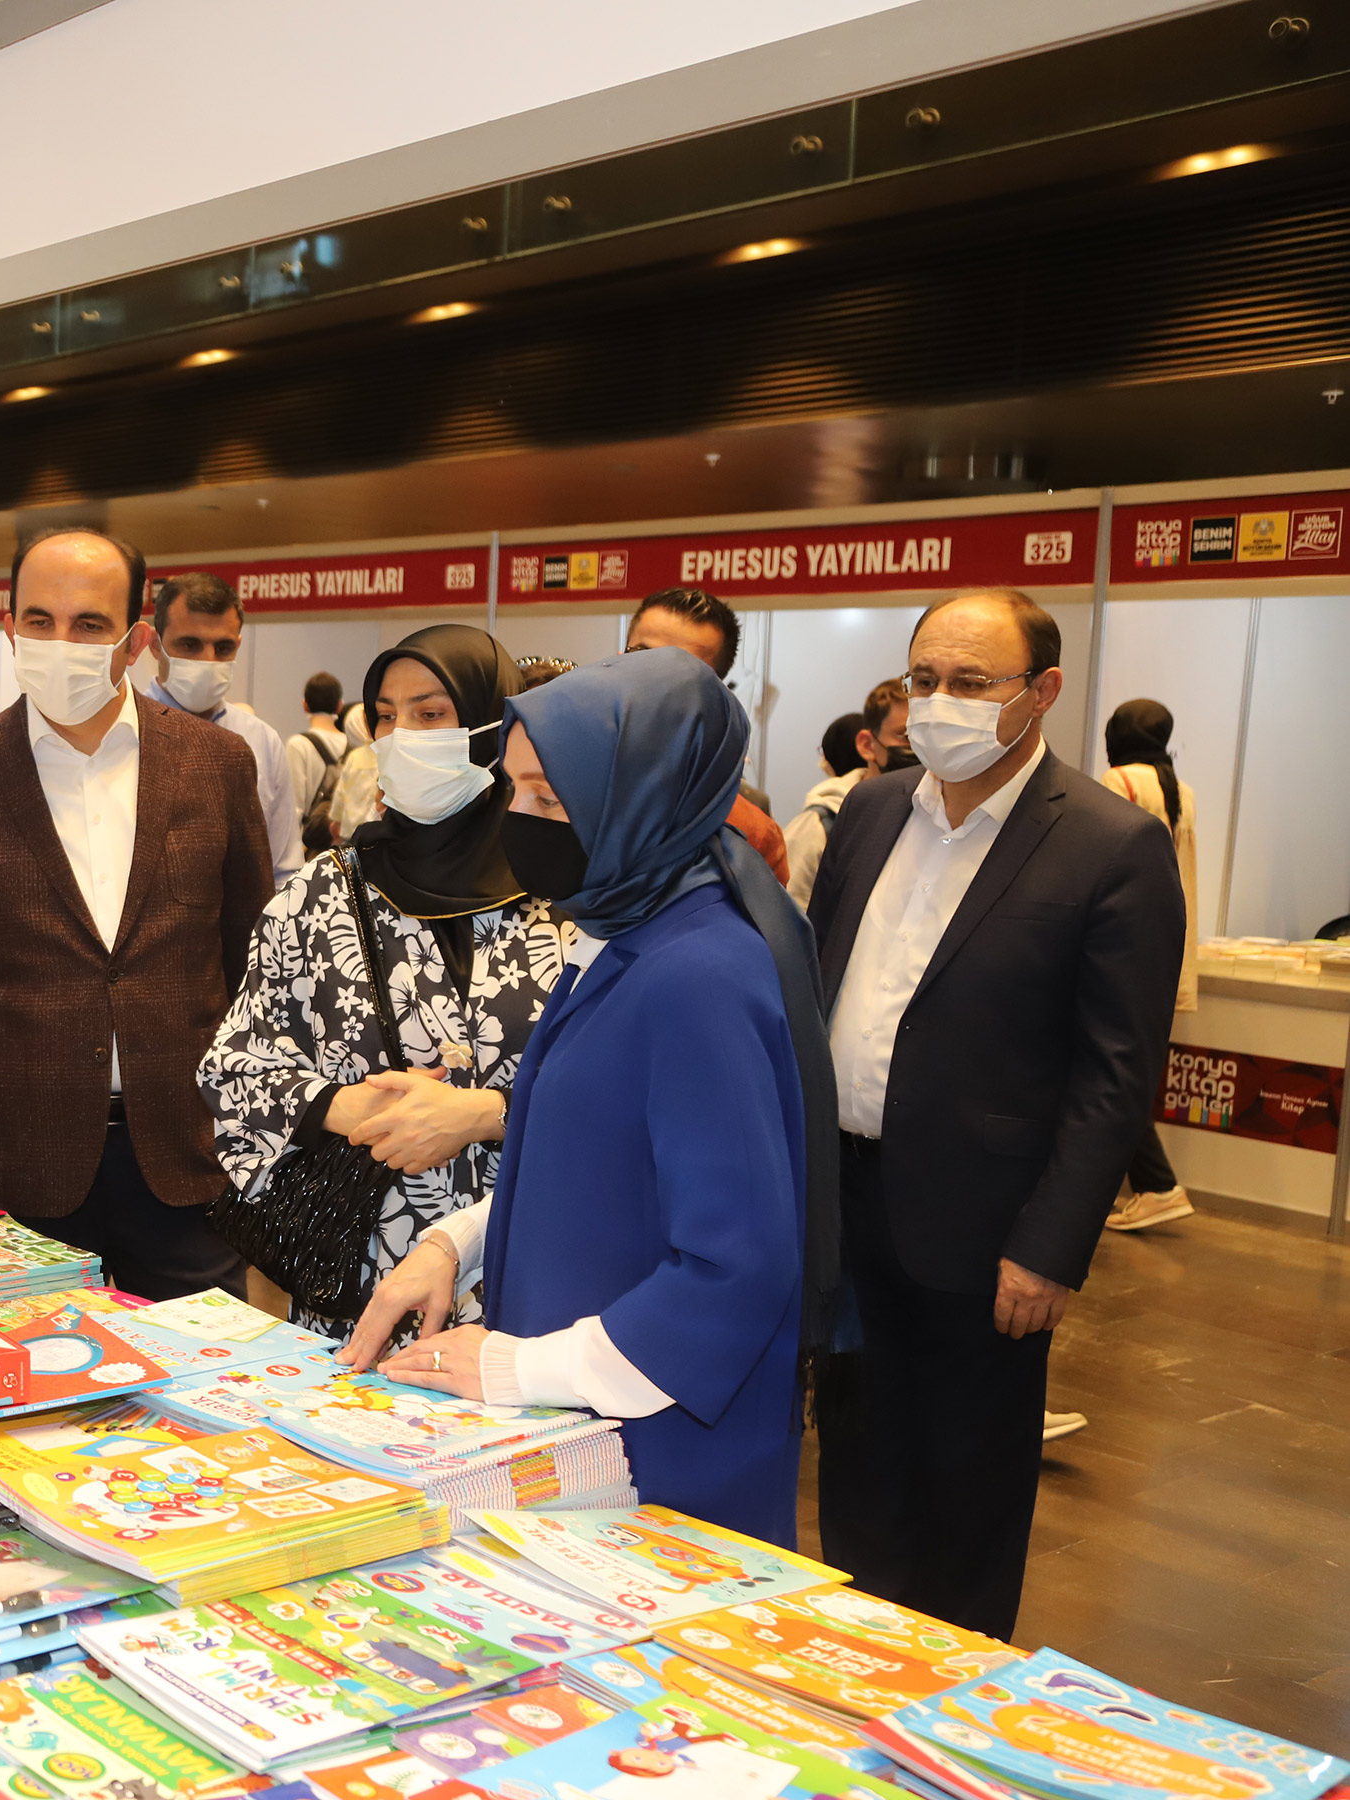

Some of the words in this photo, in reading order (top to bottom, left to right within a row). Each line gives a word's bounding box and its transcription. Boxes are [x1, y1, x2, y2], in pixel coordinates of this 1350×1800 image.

[1136, 531, 1181, 548] kitap
[1137, 519, 1182, 534] konya
[1193, 526, 1233, 541] BENİM
[681, 545, 798, 583] EPHESUS
[805, 537, 952, 577] YAYINLARI
[1030, 540, 1067, 562] 325
[238, 572, 311, 600] EPHESUS
[315, 566, 405, 597] YAYINLARI
[450, 570, 473, 588] 325
[1168, 1048, 1238, 1078] konya
[1165, 1067, 1235, 1100] kitap
[100, 1319, 203, 1364] KODLAMA
[158, 1617, 308, 1700] TANIYORUM
[199, 1665, 327, 1731] ŞEHRİMİ
[53, 1675, 228, 1785] HAYVANLAR
